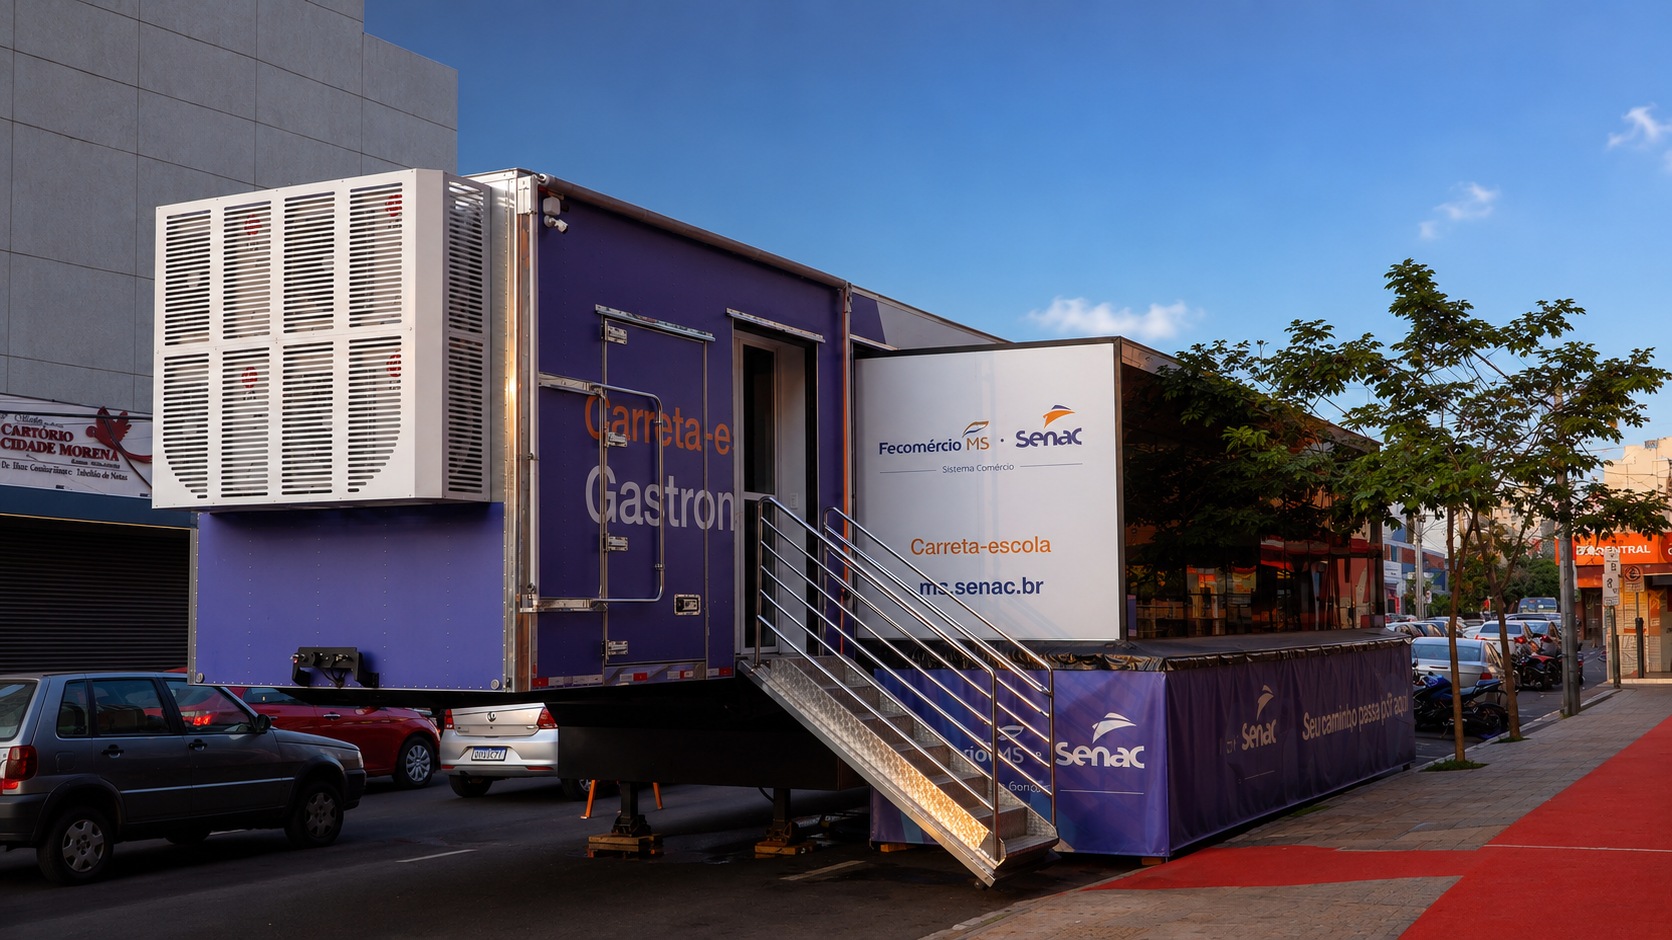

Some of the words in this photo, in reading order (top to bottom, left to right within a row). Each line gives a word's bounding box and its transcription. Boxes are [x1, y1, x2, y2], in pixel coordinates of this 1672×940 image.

[1, 422, 74, 442] CARTÓRIO
[585, 396, 735, 455] Carreta-e
[0, 437, 56, 454] CIDADE
[59, 443, 119, 462] MORENA
[879, 439, 961, 455] Fecomércio
[966, 436, 990, 451] MS
[1015, 427, 1082, 448] Senac
[942, 464, 974, 474] Sistema
[976, 462, 1015, 472] Comércio
[910, 536, 1052, 556] Carreta-escola
[919, 577, 1044, 596] ms.senac.br
[1302, 712, 1321, 740] Seu
[1358, 702, 1381, 732] passa
[1241, 719, 1277, 751] Senac
[1055, 742, 1146, 769] Senac
